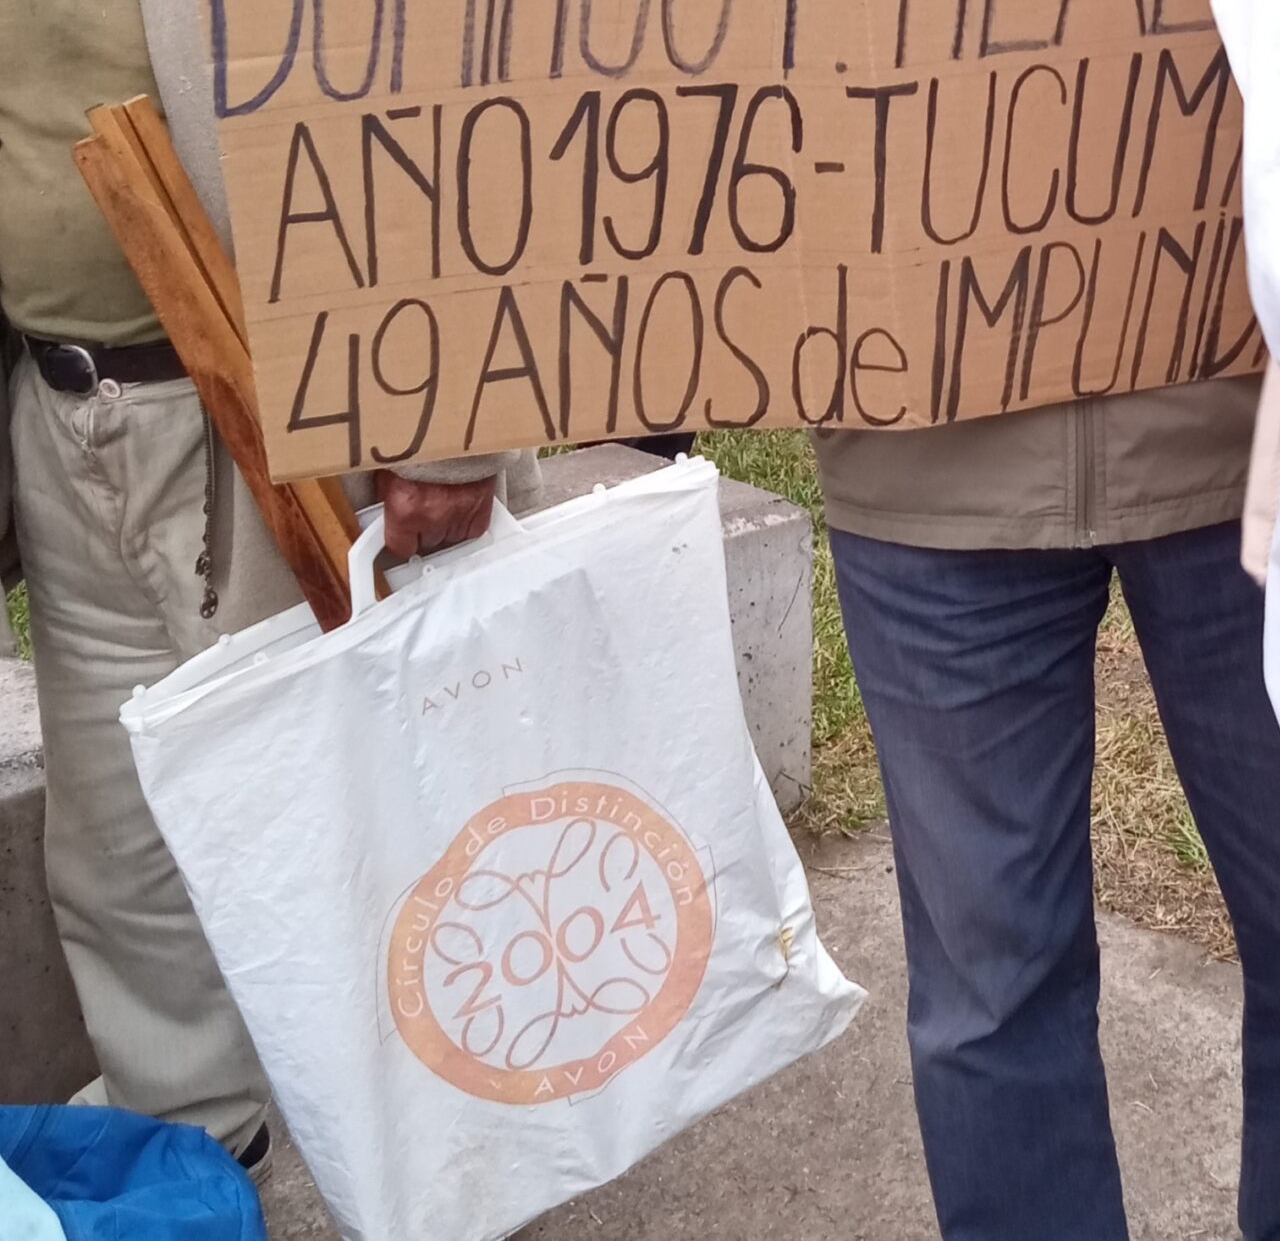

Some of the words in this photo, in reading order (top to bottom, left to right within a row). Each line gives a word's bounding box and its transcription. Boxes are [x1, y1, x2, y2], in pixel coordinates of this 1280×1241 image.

[268, 96, 533, 304] AÑO
[285, 297, 441, 468] 49
[463, 266, 770, 451] AÑOS
[791, 263, 908, 426] de
[421, 657, 524, 716] AVON
[398, 877, 454, 1018] Círculo
[464, 815, 507, 858] de
[530, 792, 694, 906] Distinción
[442, 879, 662, 1020] 2004
[534, 1026, 649, 1096] AVON
